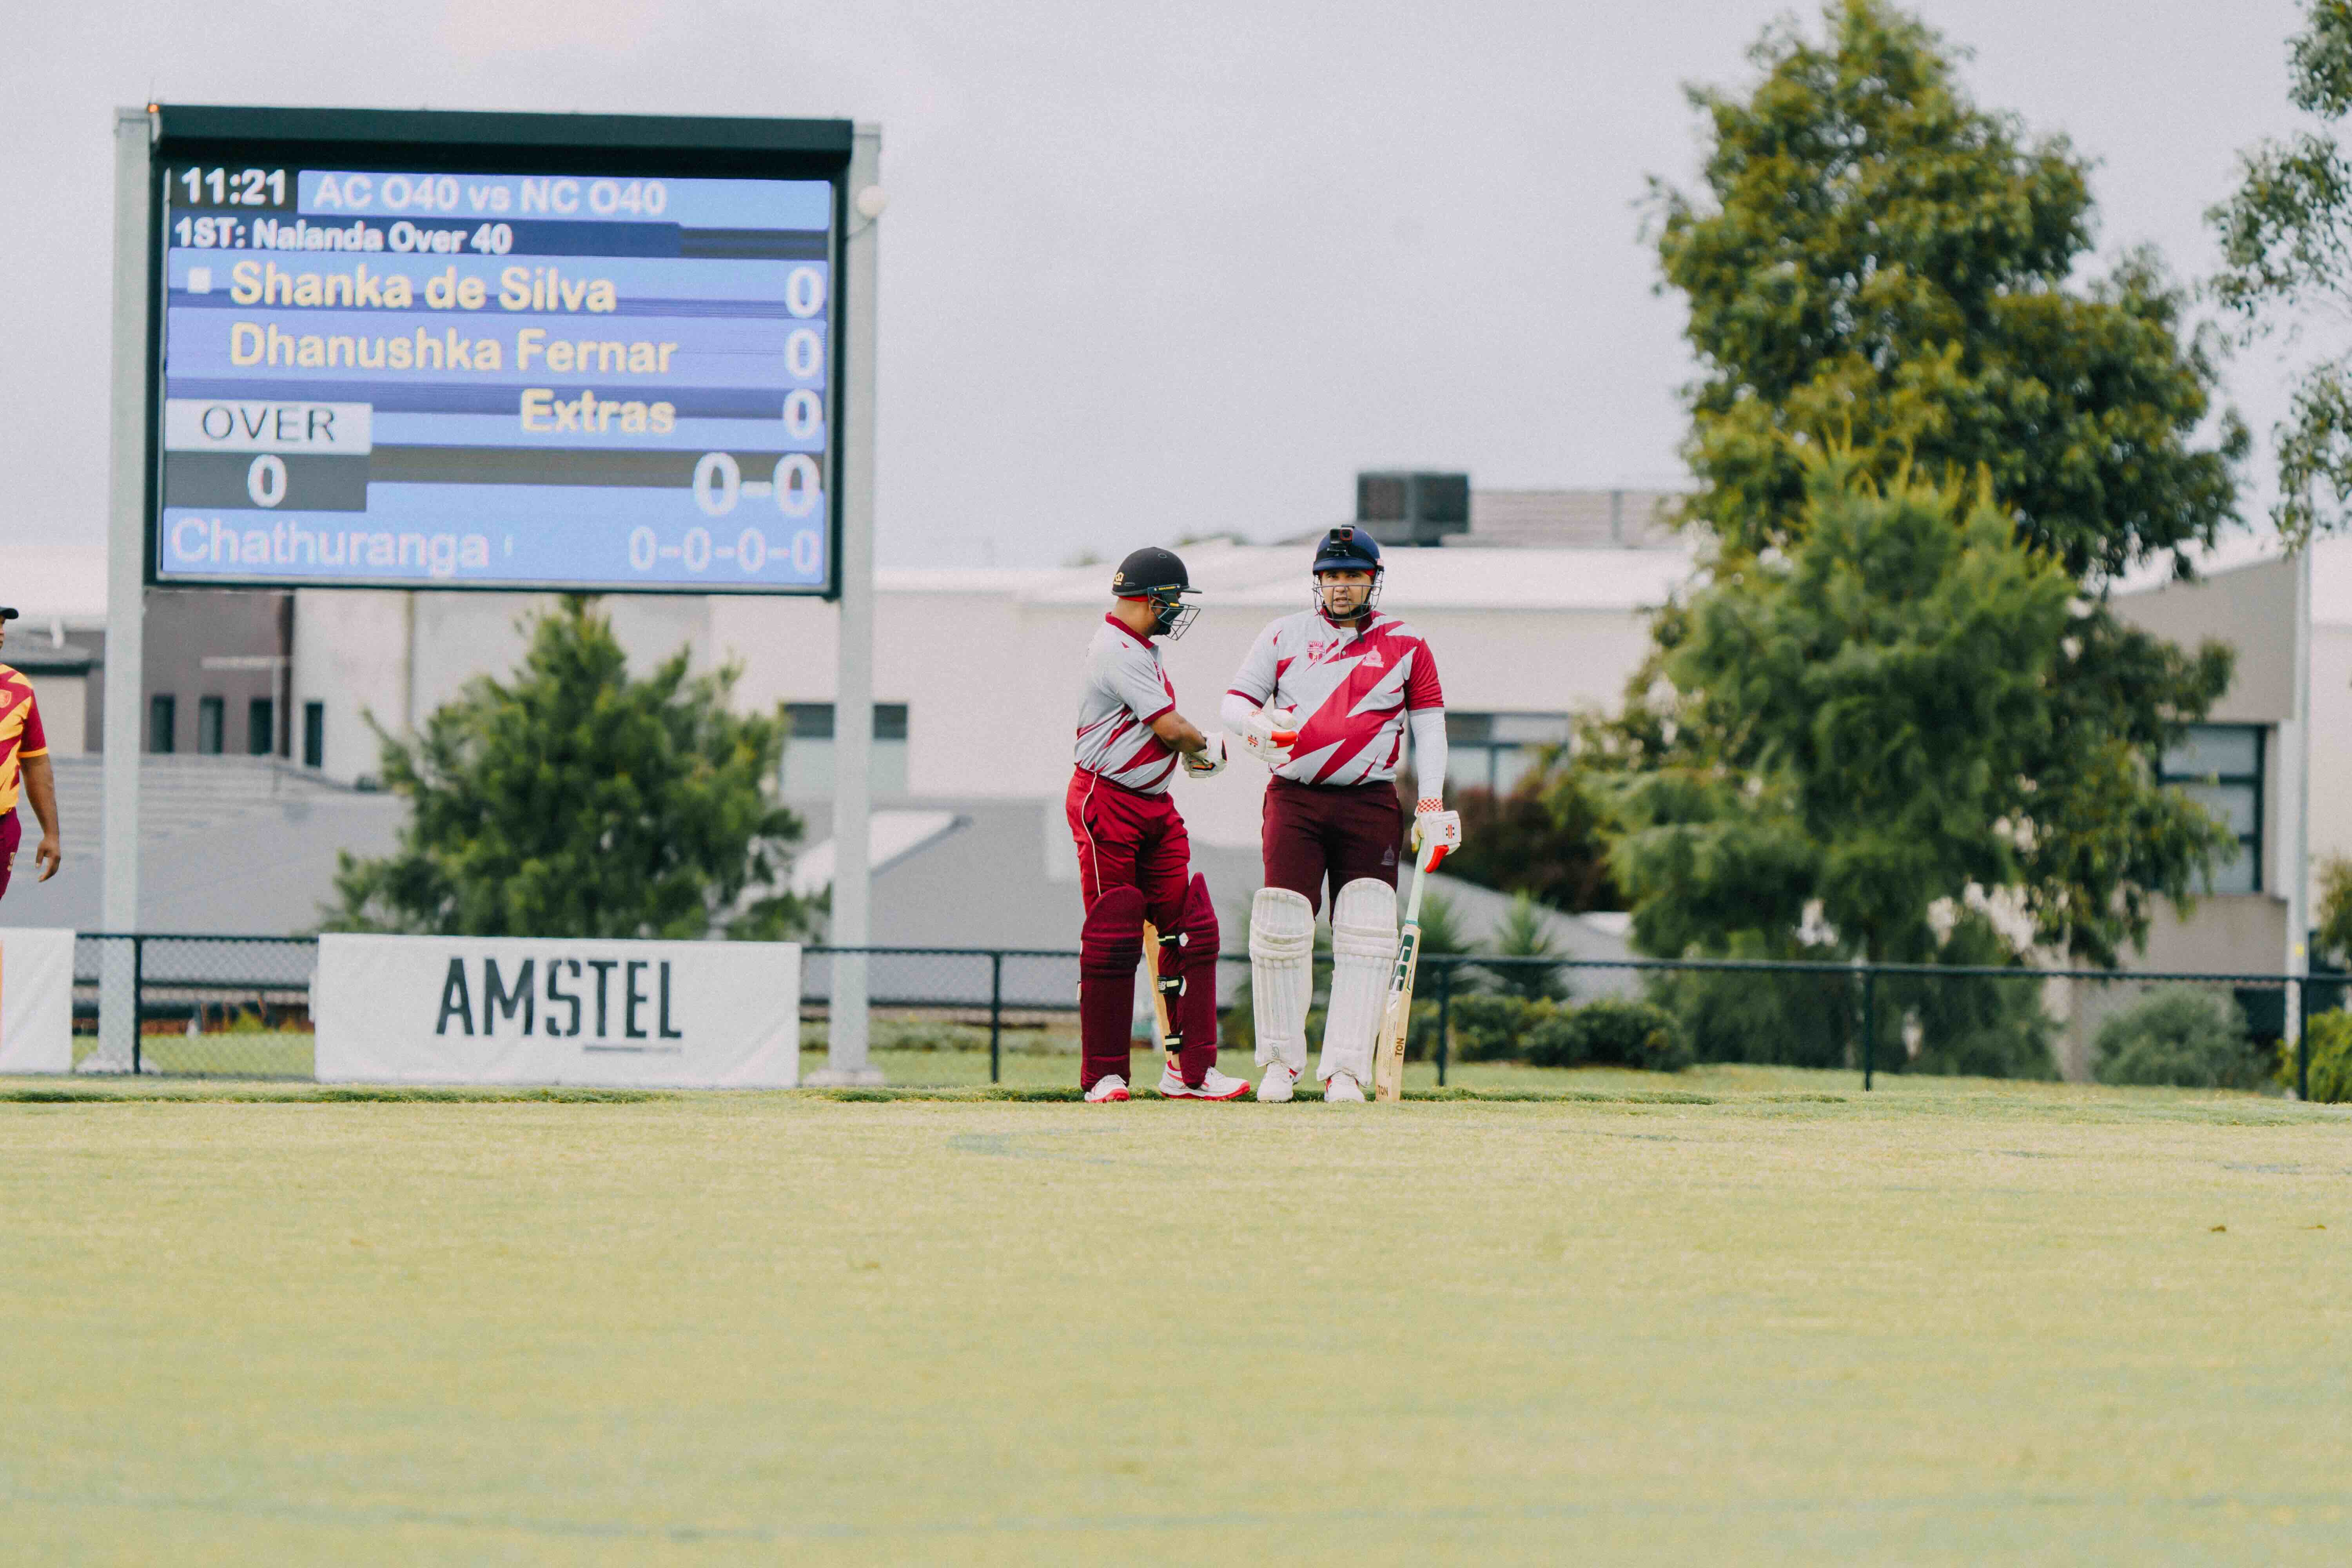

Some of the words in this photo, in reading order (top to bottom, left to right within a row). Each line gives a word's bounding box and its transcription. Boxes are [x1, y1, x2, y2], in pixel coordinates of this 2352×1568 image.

[181, 167, 286, 205] 11:21
[313, 175, 372, 209] AC
[469, 185, 511, 212] vs
[521, 178, 578, 213] NC
[175, 216, 246, 248] 1ST:
[253, 218, 384, 252] Nalanda
[388, 221, 468, 253] Over
[471, 223, 513, 255] 40
[230, 260, 412, 308] Shanka
[425, 265, 486, 310] de
[498, 266, 617, 313] Silva
[785, 267, 824, 318] 0
[231, 321, 503, 370] Dhanushka
[516, 328, 679, 374] Fernar
[785, 328, 823, 380] 0
[202, 406, 336, 442] OVER
[520, 388, 676, 435] Extras
[783, 388, 823, 439] 0
[248, 454, 288, 508] 0
[171, 517, 489, 579] Chathuranga
[436, 957, 682, 1039] AMSTEL
[1395, 1038, 1404, 1057] TON
[1377, 1085, 1388, 1097] TON
